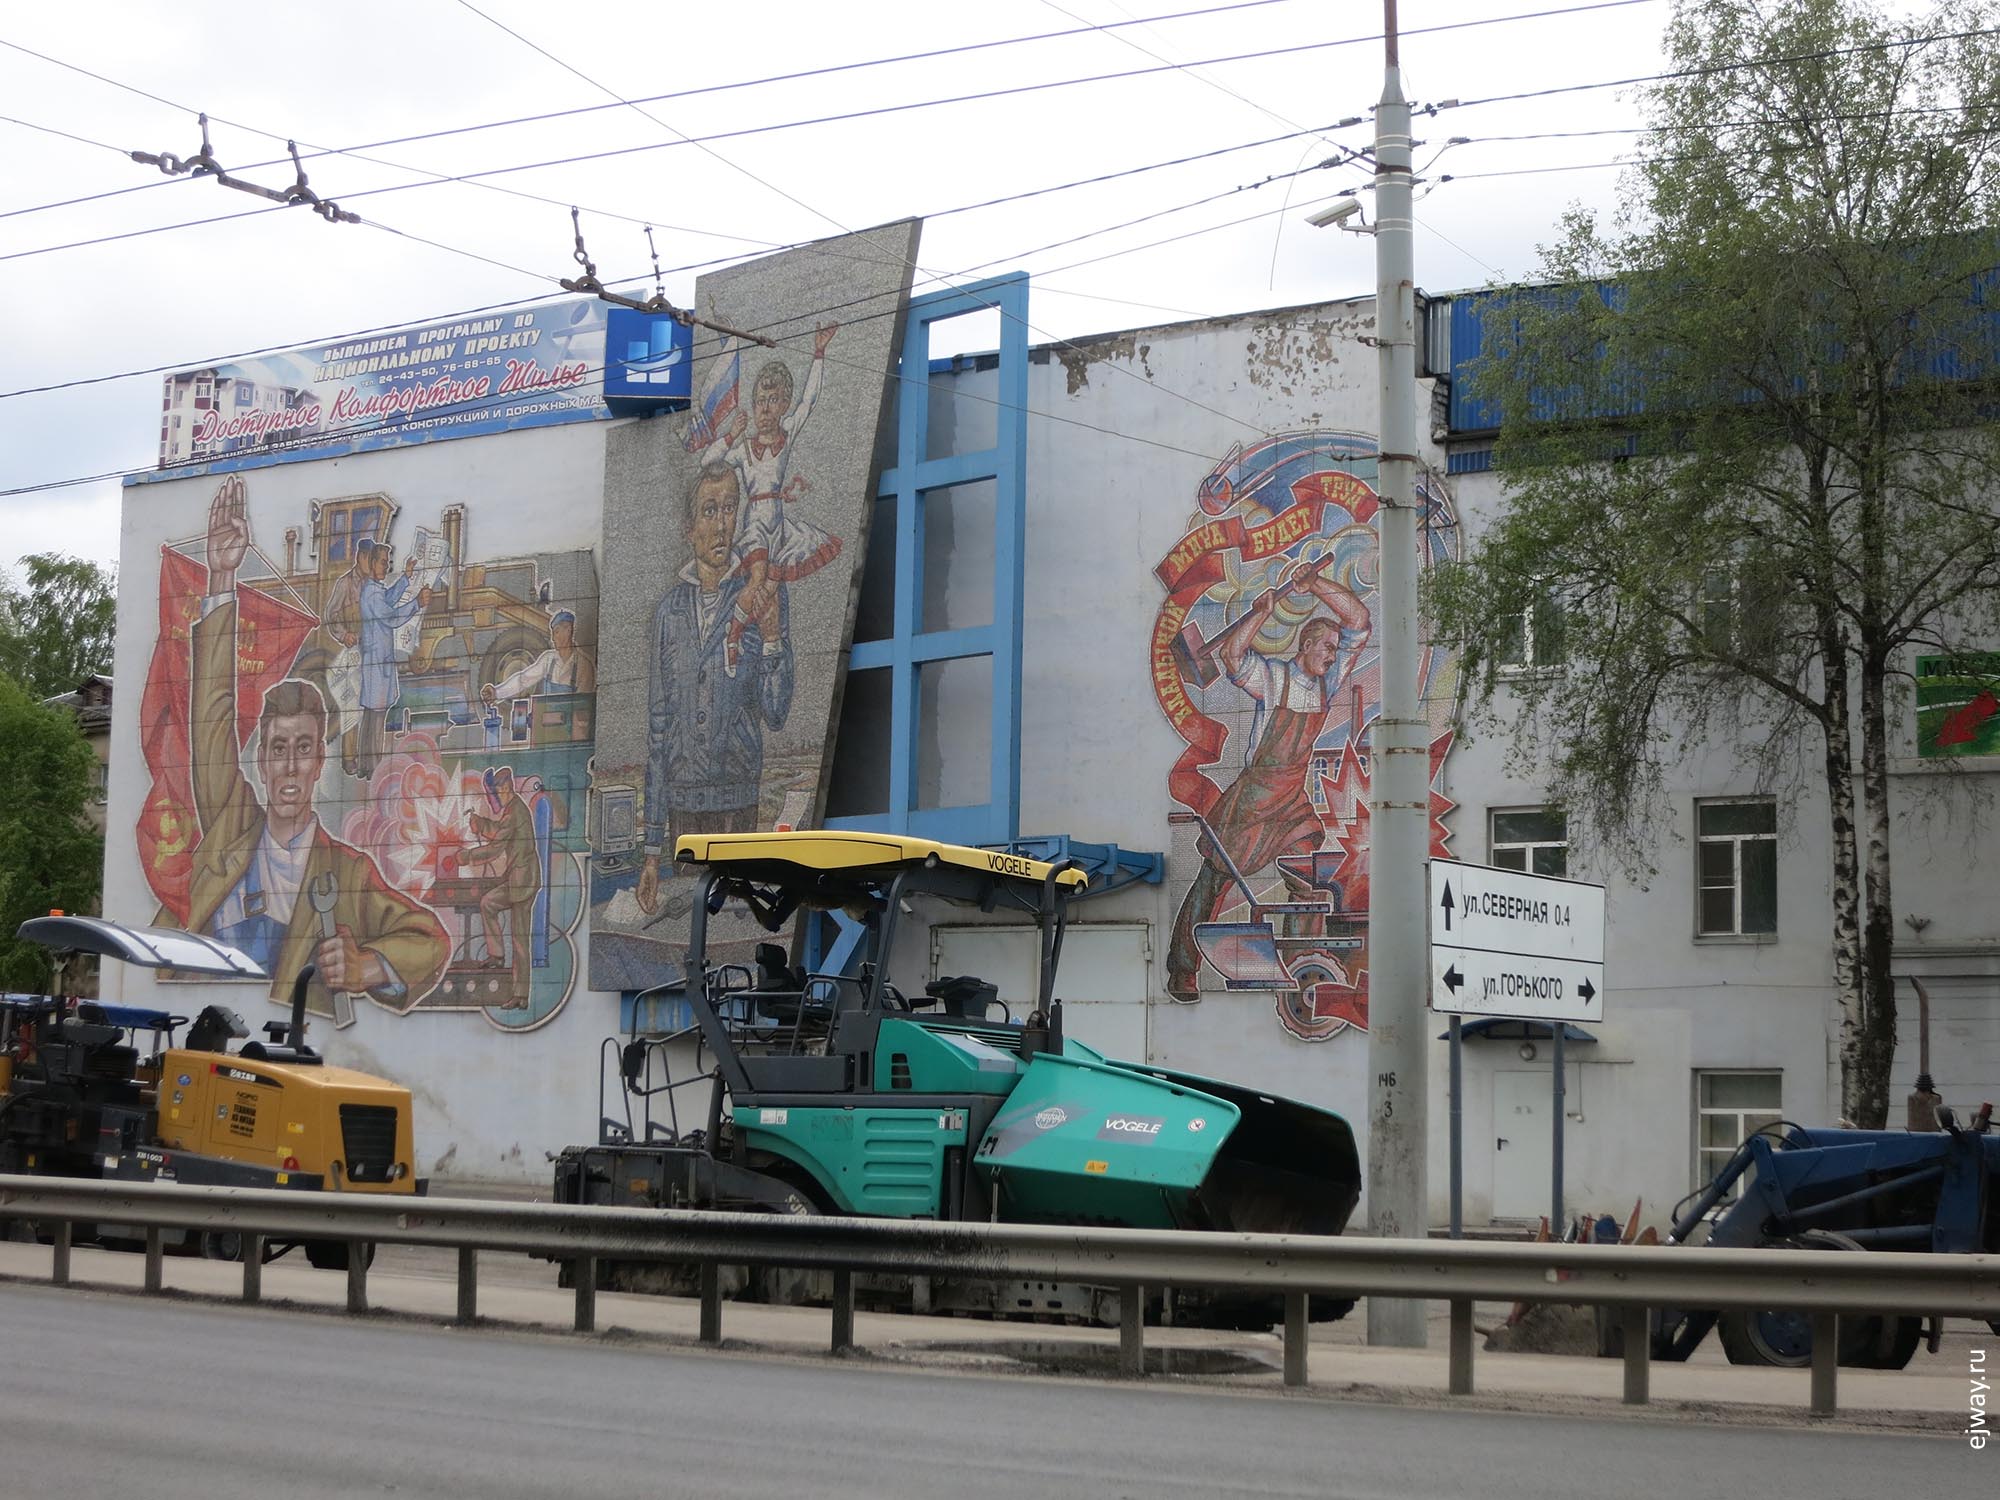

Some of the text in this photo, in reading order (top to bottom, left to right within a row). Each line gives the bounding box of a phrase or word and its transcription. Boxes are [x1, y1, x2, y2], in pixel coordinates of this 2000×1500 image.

[313, 329, 542, 383] НАЦИОНАЛЬНОМУ ПРОЕКТУ
[323, 312, 535, 363] ВЫПОЛНЯЕМ ПРОГРАММУ ПО
[195, 358, 588, 443] Доступное Комфортное Жилье
[401, 409, 489, 432] КОНСТРУКЦИЙ
[505, 399, 577, 417] ДОРОЖНЫХ
[1168, 521, 1227, 573] МИРА
[1252, 507, 1312, 554] БУДЕТ
[1320, 475, 1370, 509] ТРУД
[1554, 904, 1571, 927] 0.4
[1378, 1072, 1397, 1088] 146
[1384, 1101, 1393, 1118] 3
